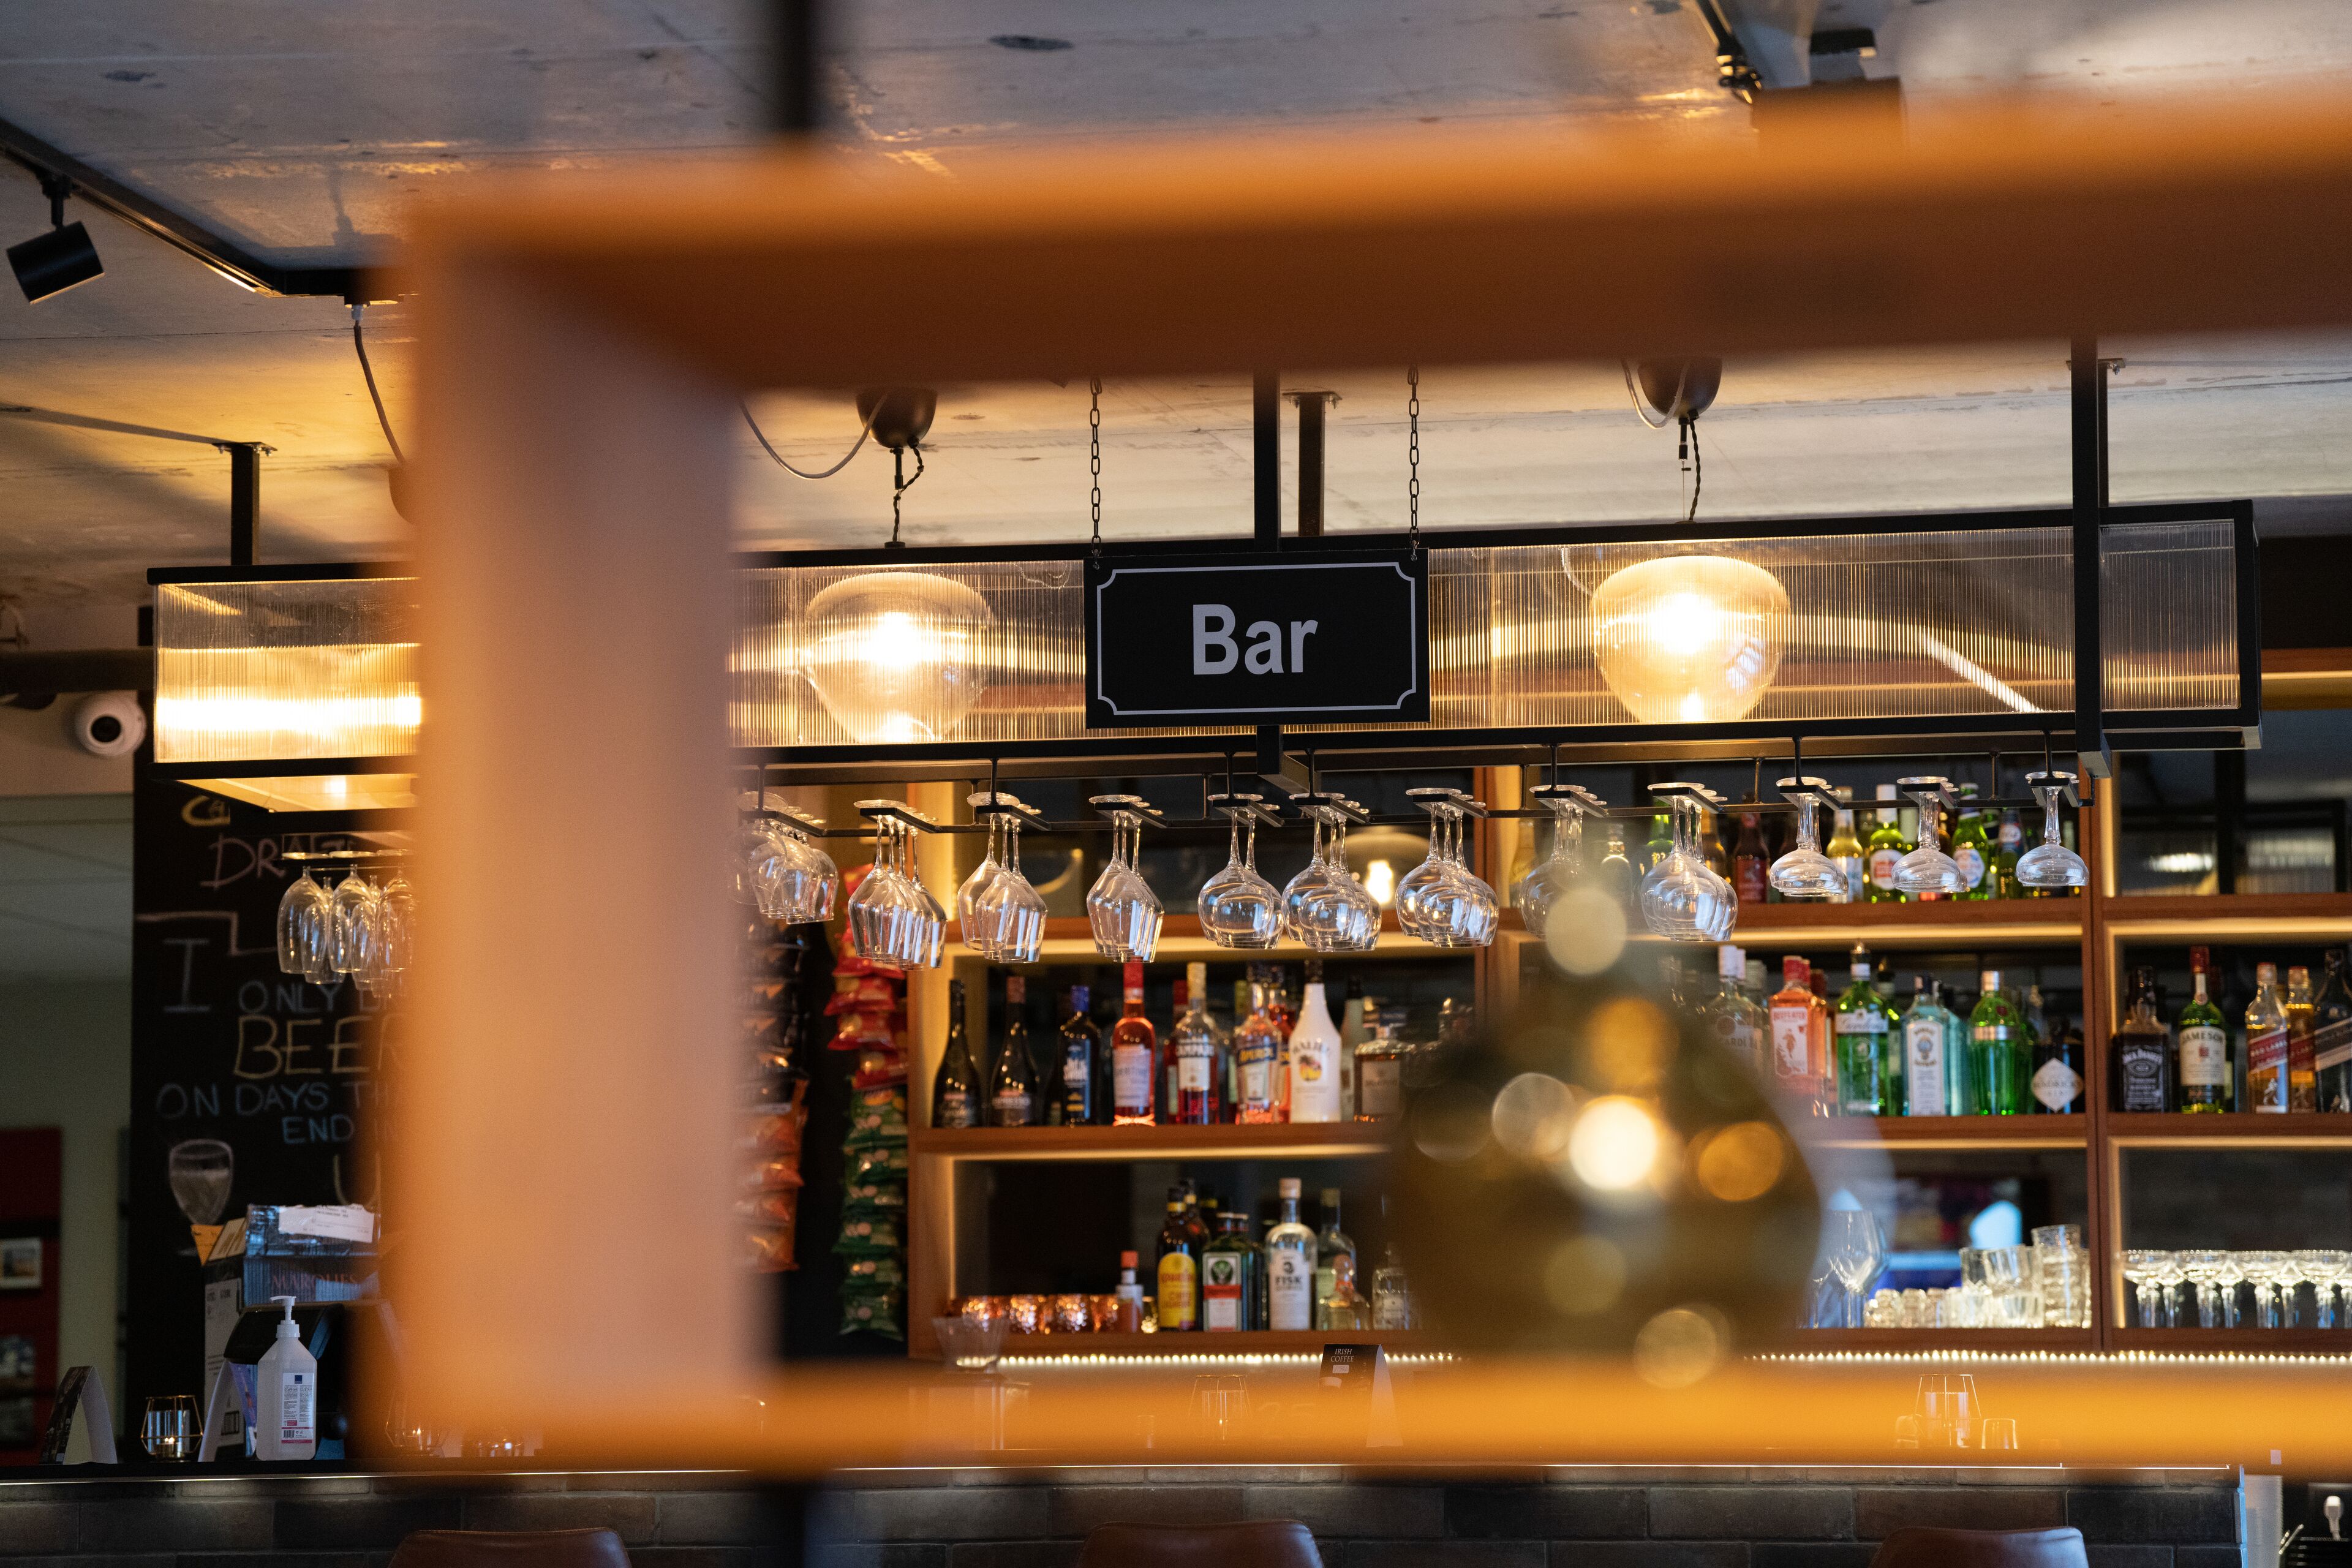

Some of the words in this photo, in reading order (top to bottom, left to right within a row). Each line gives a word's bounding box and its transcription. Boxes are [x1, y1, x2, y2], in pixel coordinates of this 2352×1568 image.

[1193, 604, 1318, 675] Bar
[163, 938, 210, 1013] I
[238, 981, 344, 1014] ONLY
[156, 1083, 219, 1120] ON
[235, 1083, 330, 1117] DAYS
[282, 1116, 354, 1144] END
